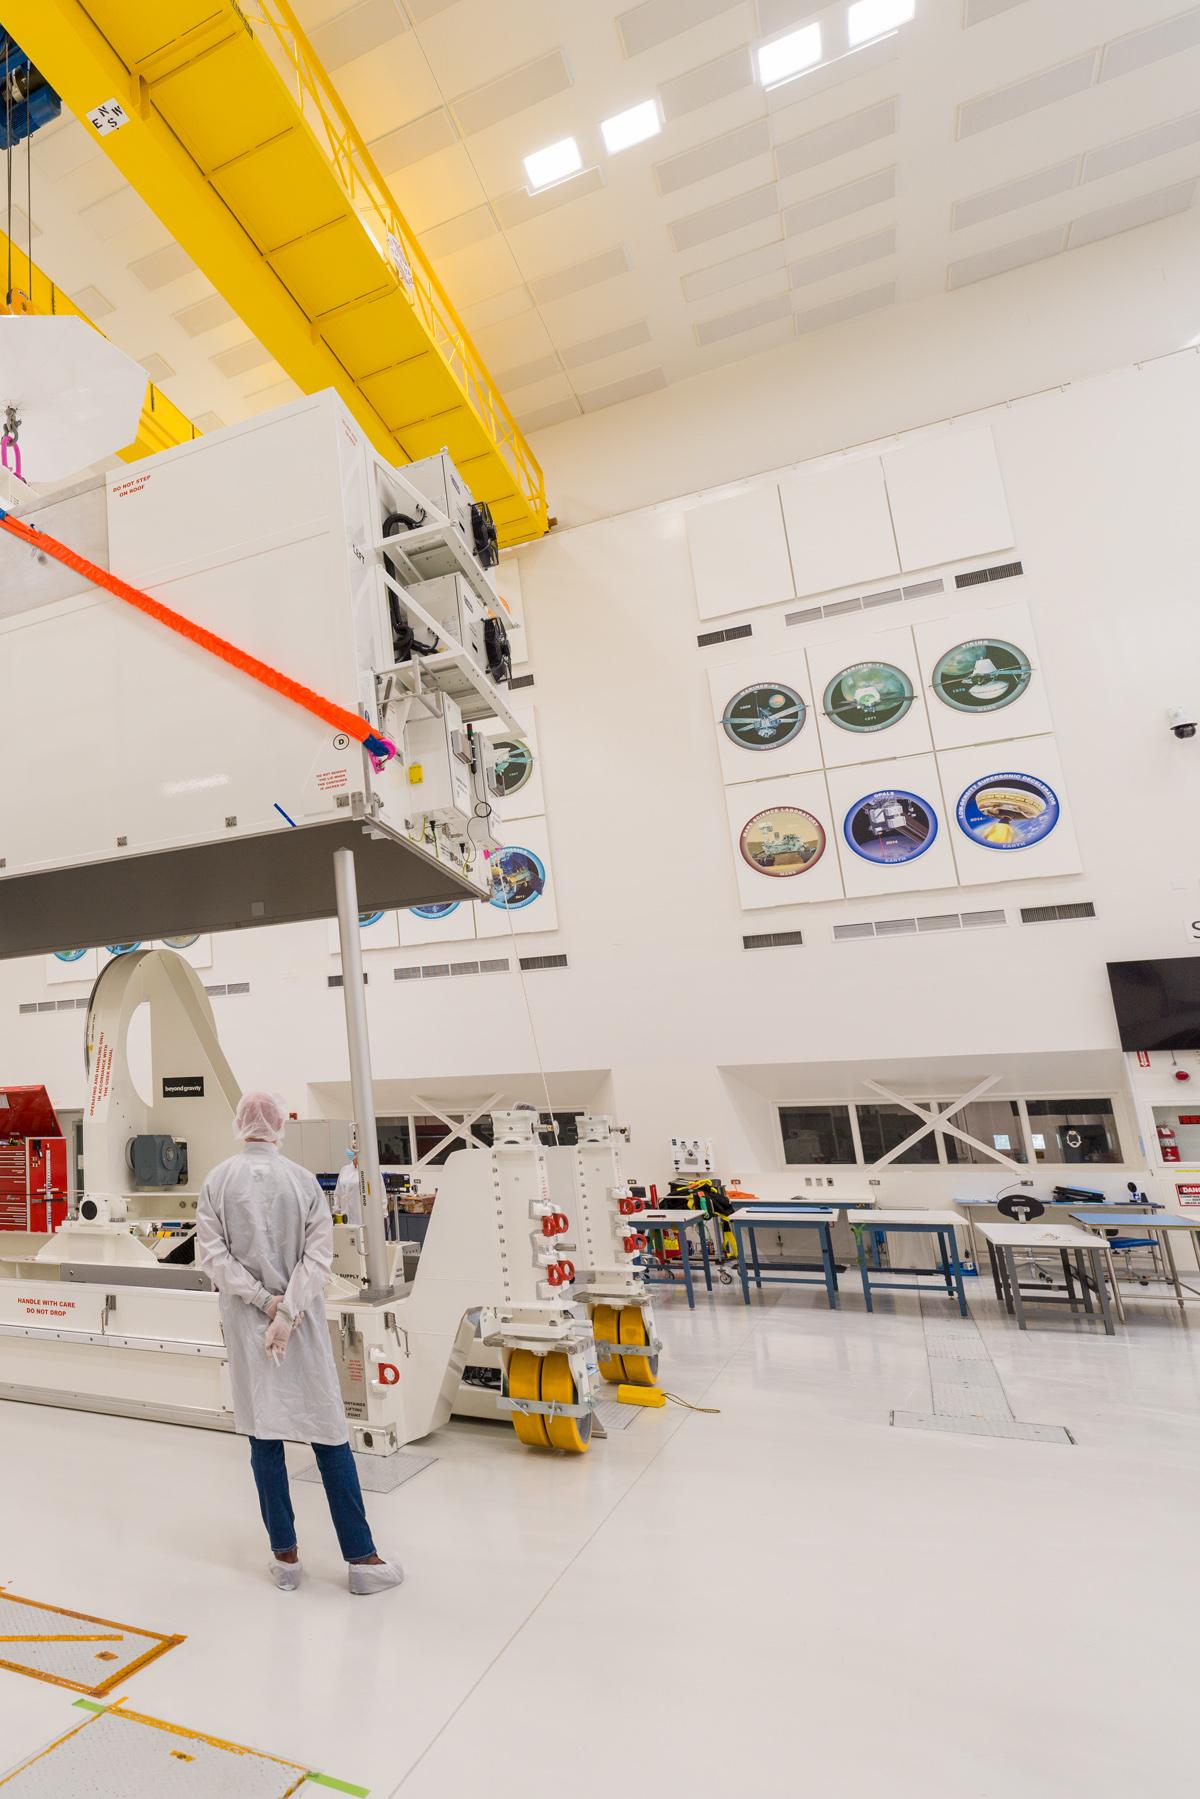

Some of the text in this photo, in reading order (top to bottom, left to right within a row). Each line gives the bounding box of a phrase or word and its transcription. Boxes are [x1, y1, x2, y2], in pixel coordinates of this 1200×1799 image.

[98, 105, 122, 117] N W
[92, 118, 118, 130] E S
[122, 481, 134, 490] NOT
[136, 475, 151, 485] STEP
[119, 485, 145, 498] ON ROOF
[961, 640, 988, 649] VIKING
[977, 774, 1022, 786] SUPERSONIC
[1022, 775, 1056, 805] DECELERATOR
[780, 808, 819, 826] LABORATORY
